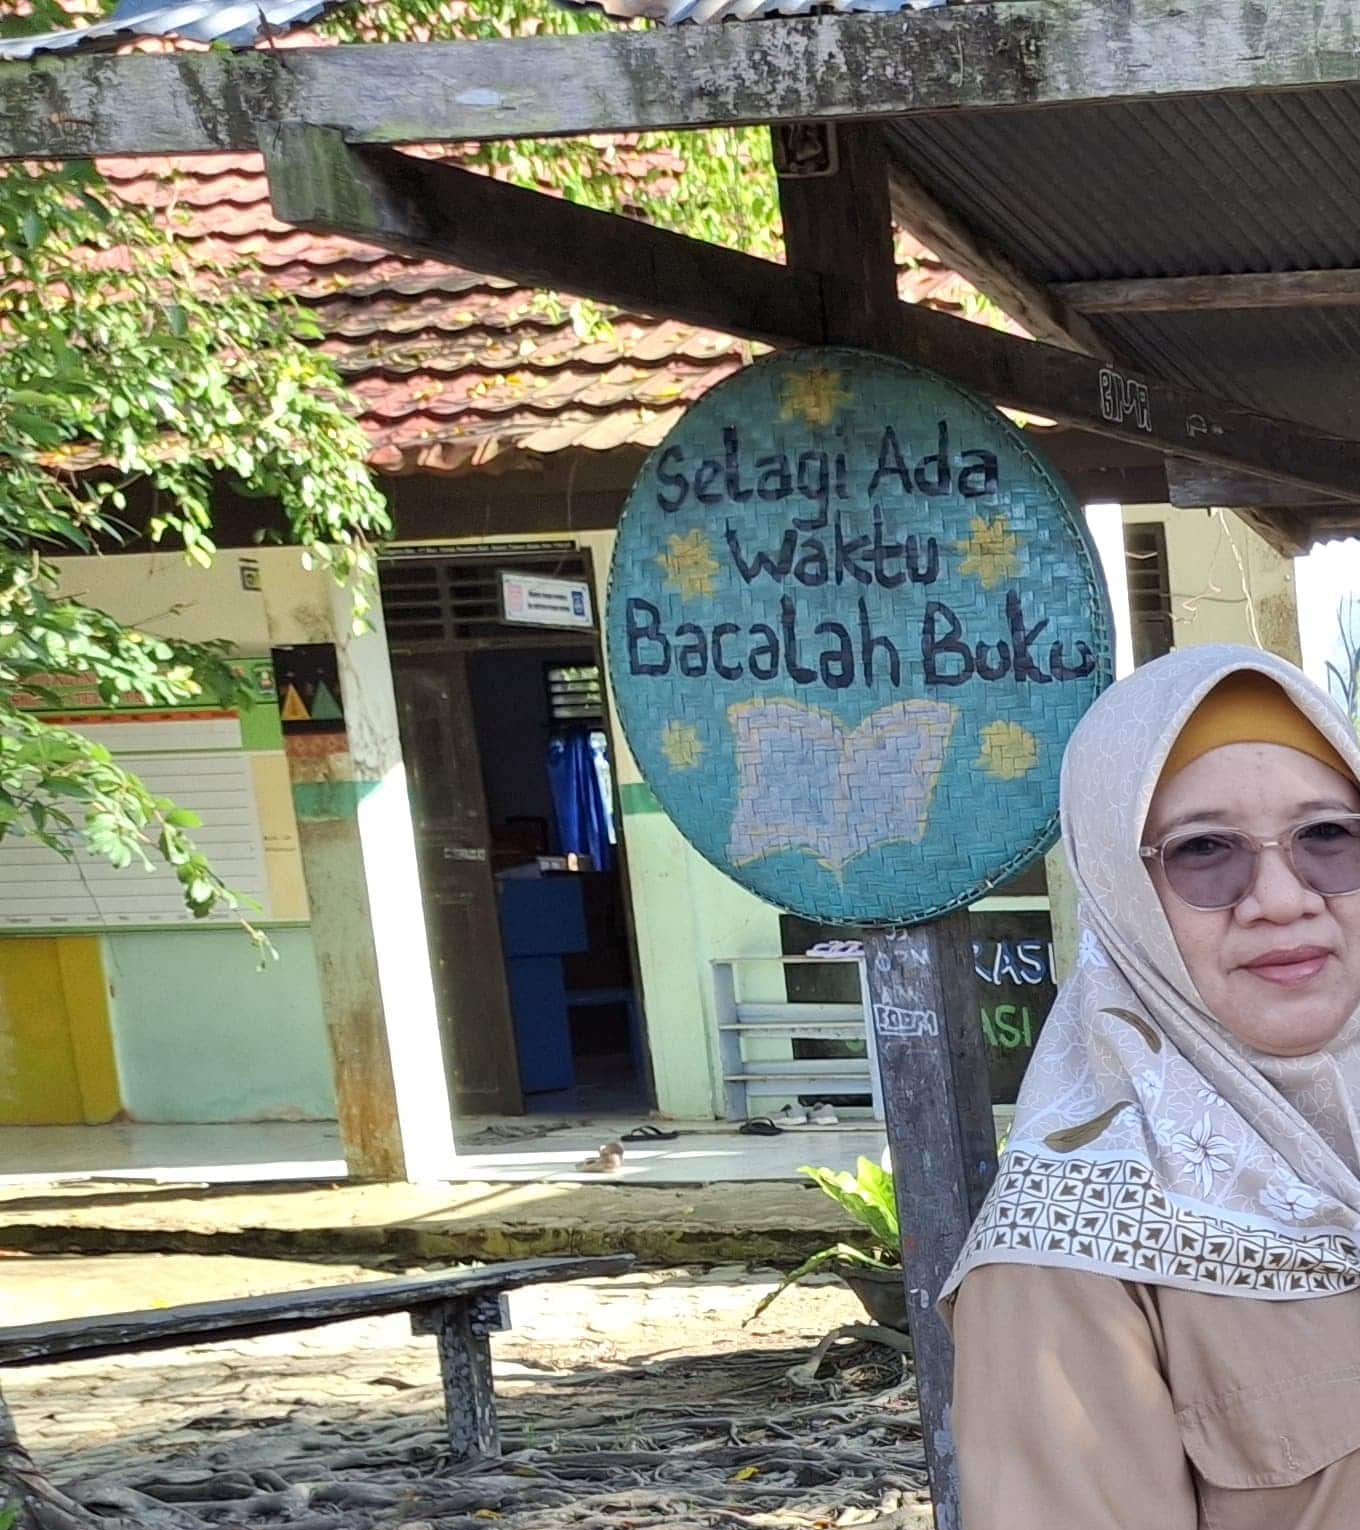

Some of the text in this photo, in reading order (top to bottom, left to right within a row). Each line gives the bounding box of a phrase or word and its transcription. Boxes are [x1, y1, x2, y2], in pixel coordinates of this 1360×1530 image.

[655, 420, 1000, 531] Selagi Ada
[625, 589, 1097, 688] Bacalah Buku
